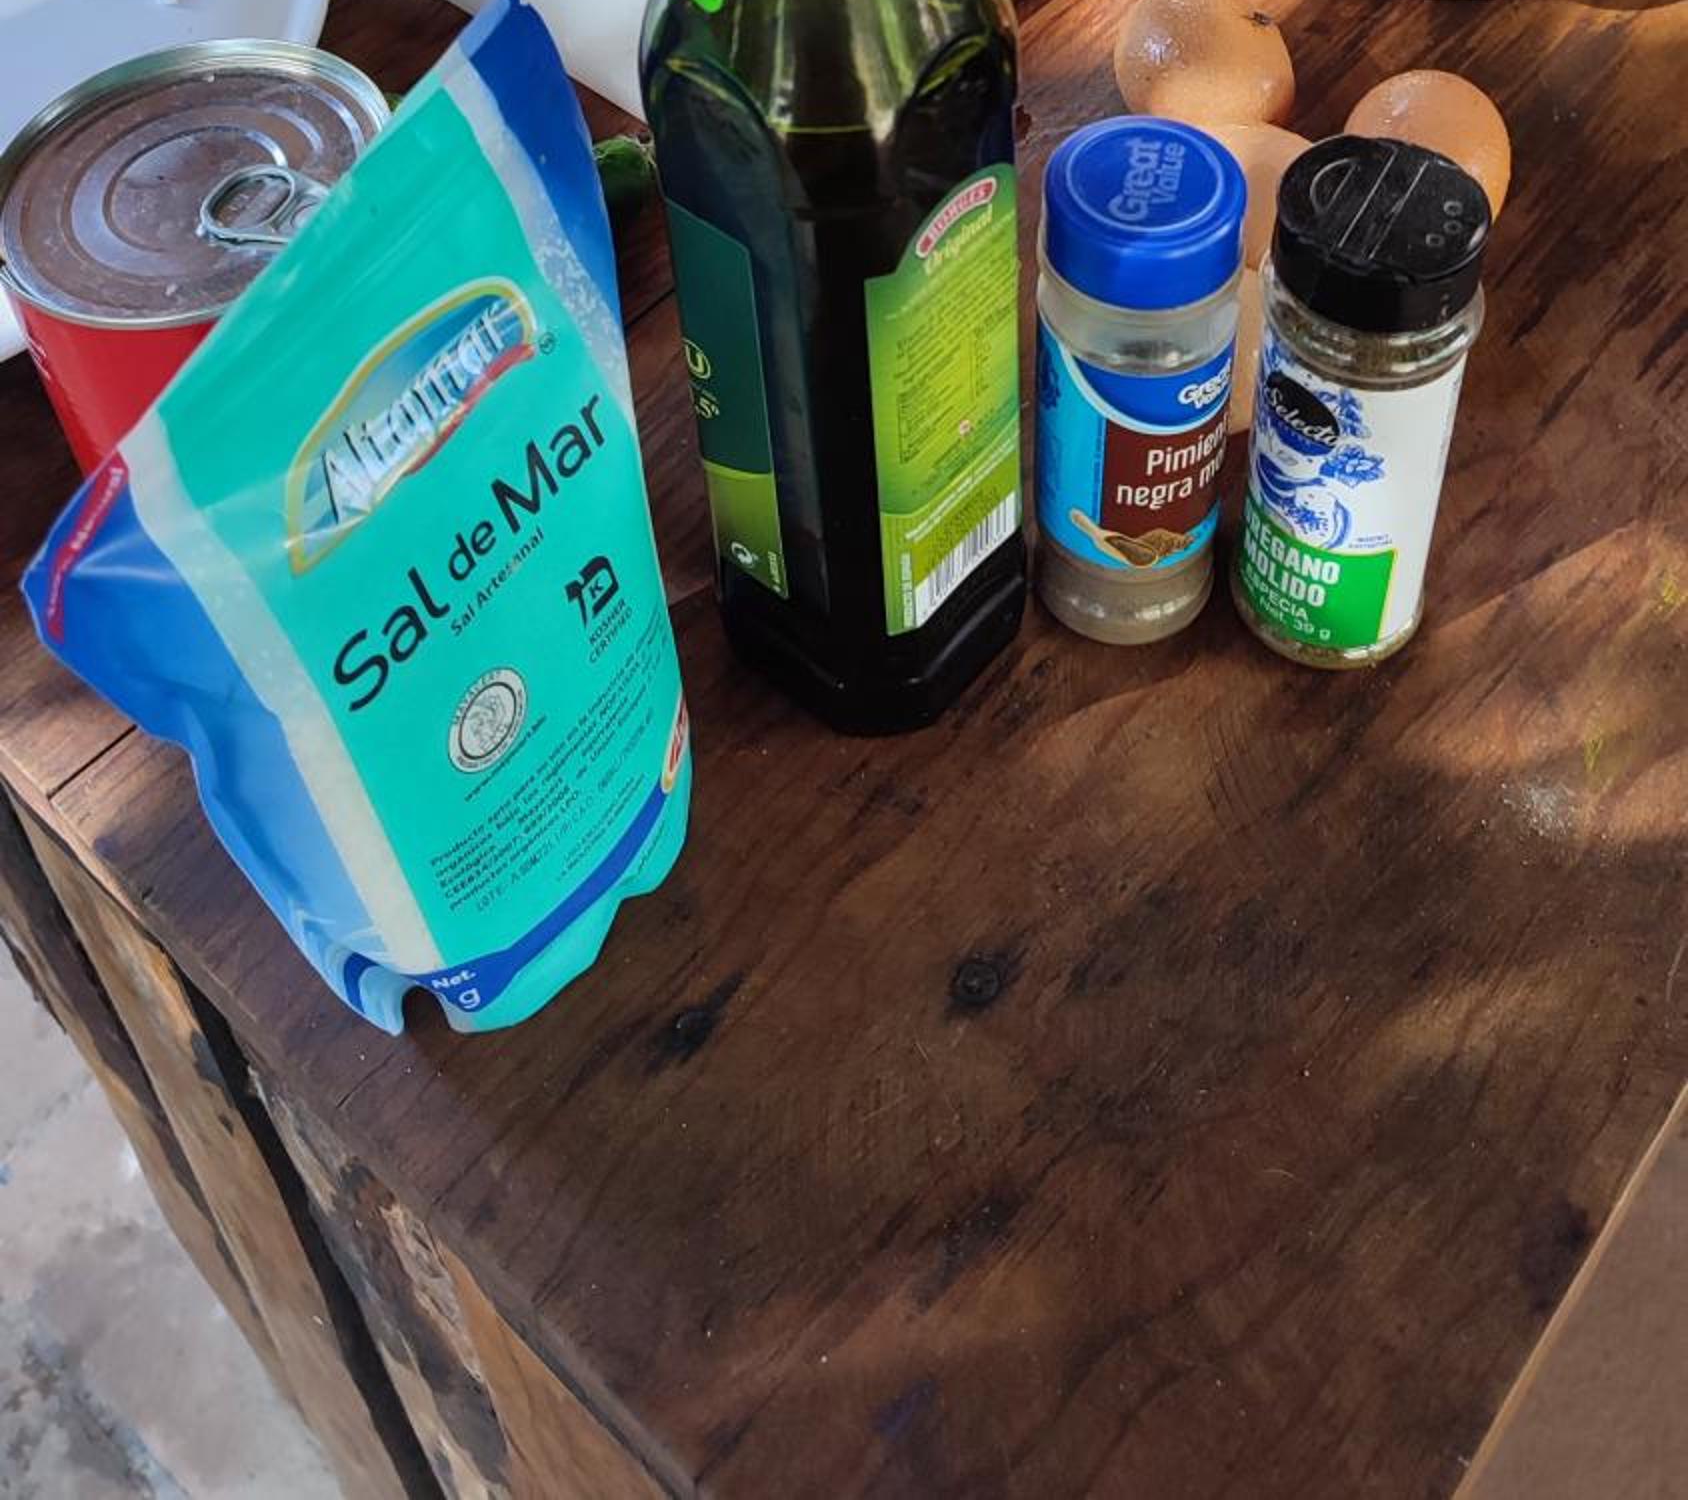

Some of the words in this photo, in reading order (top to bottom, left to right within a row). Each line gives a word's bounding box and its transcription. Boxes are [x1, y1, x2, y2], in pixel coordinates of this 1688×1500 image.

[1107, 136, 1163, 222] Great
[1150, 140, 1186, 205] Value
[1115, 475, 1194, 510] negra
[333, 566, 451, 713] Sal
[447, 520, 497, 582] de
[490, 393, 605, 536] Mar
[450, 604, 477, 637] Sal
[475, 525, 546, 610] Artesanal
[458, 987, 481, 1009] g
